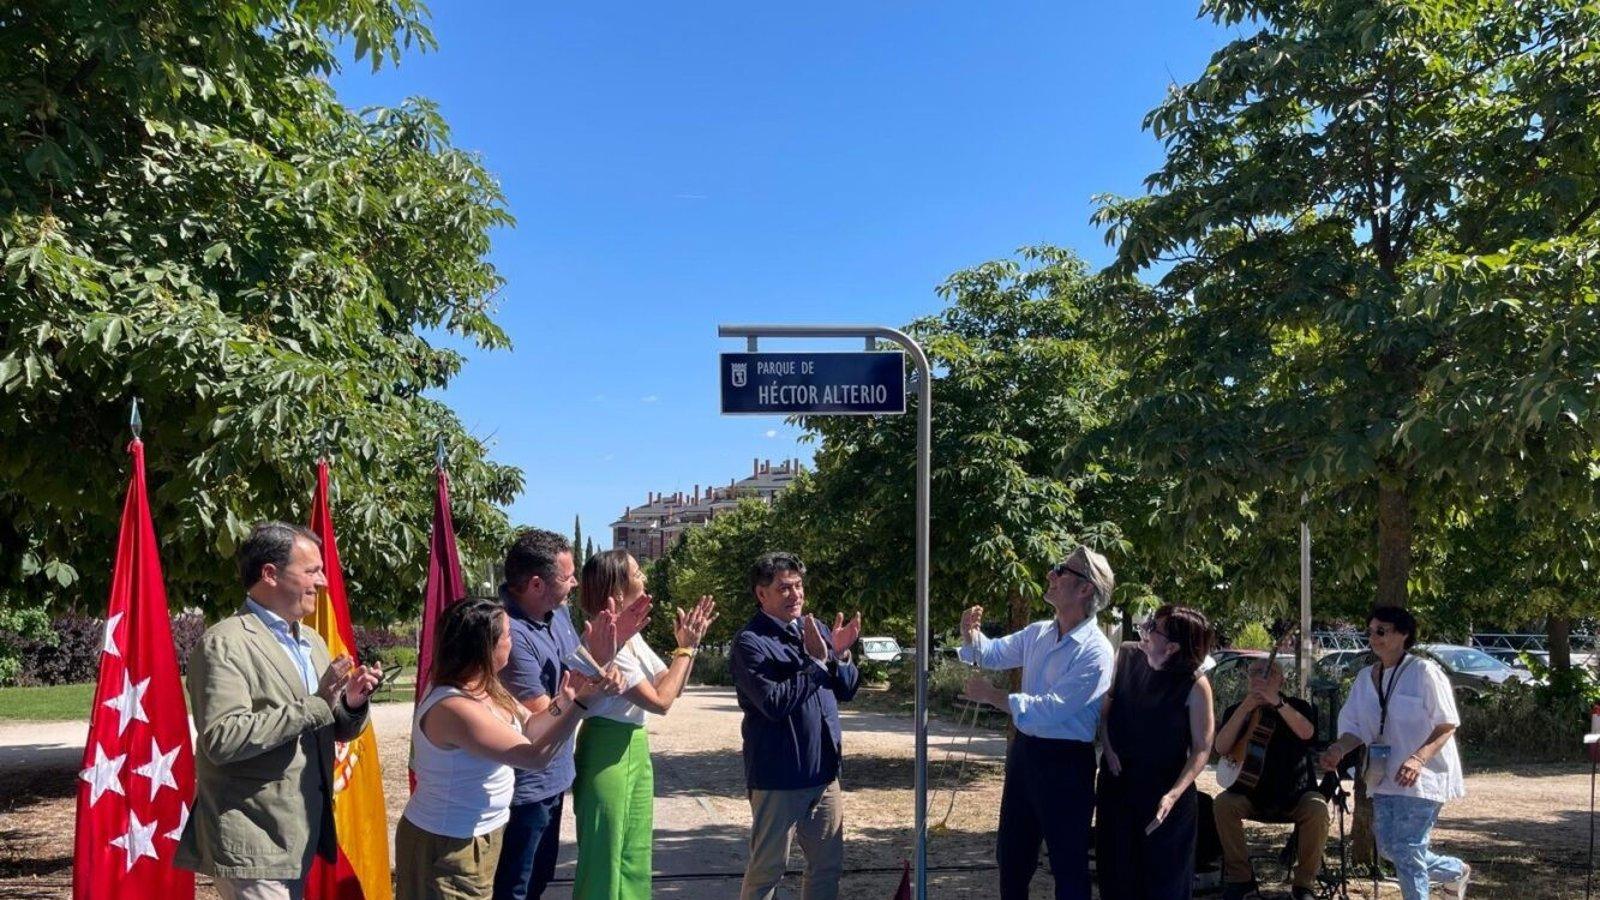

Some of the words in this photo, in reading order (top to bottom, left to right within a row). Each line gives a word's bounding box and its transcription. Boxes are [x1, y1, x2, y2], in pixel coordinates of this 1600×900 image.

[757, 361, 795, 375] PARQUE
[801, 361, 814, 374] DE
[758, 381, 818, 404] HÉCTOR
[823, 385, 887, 404] ALTERIO
